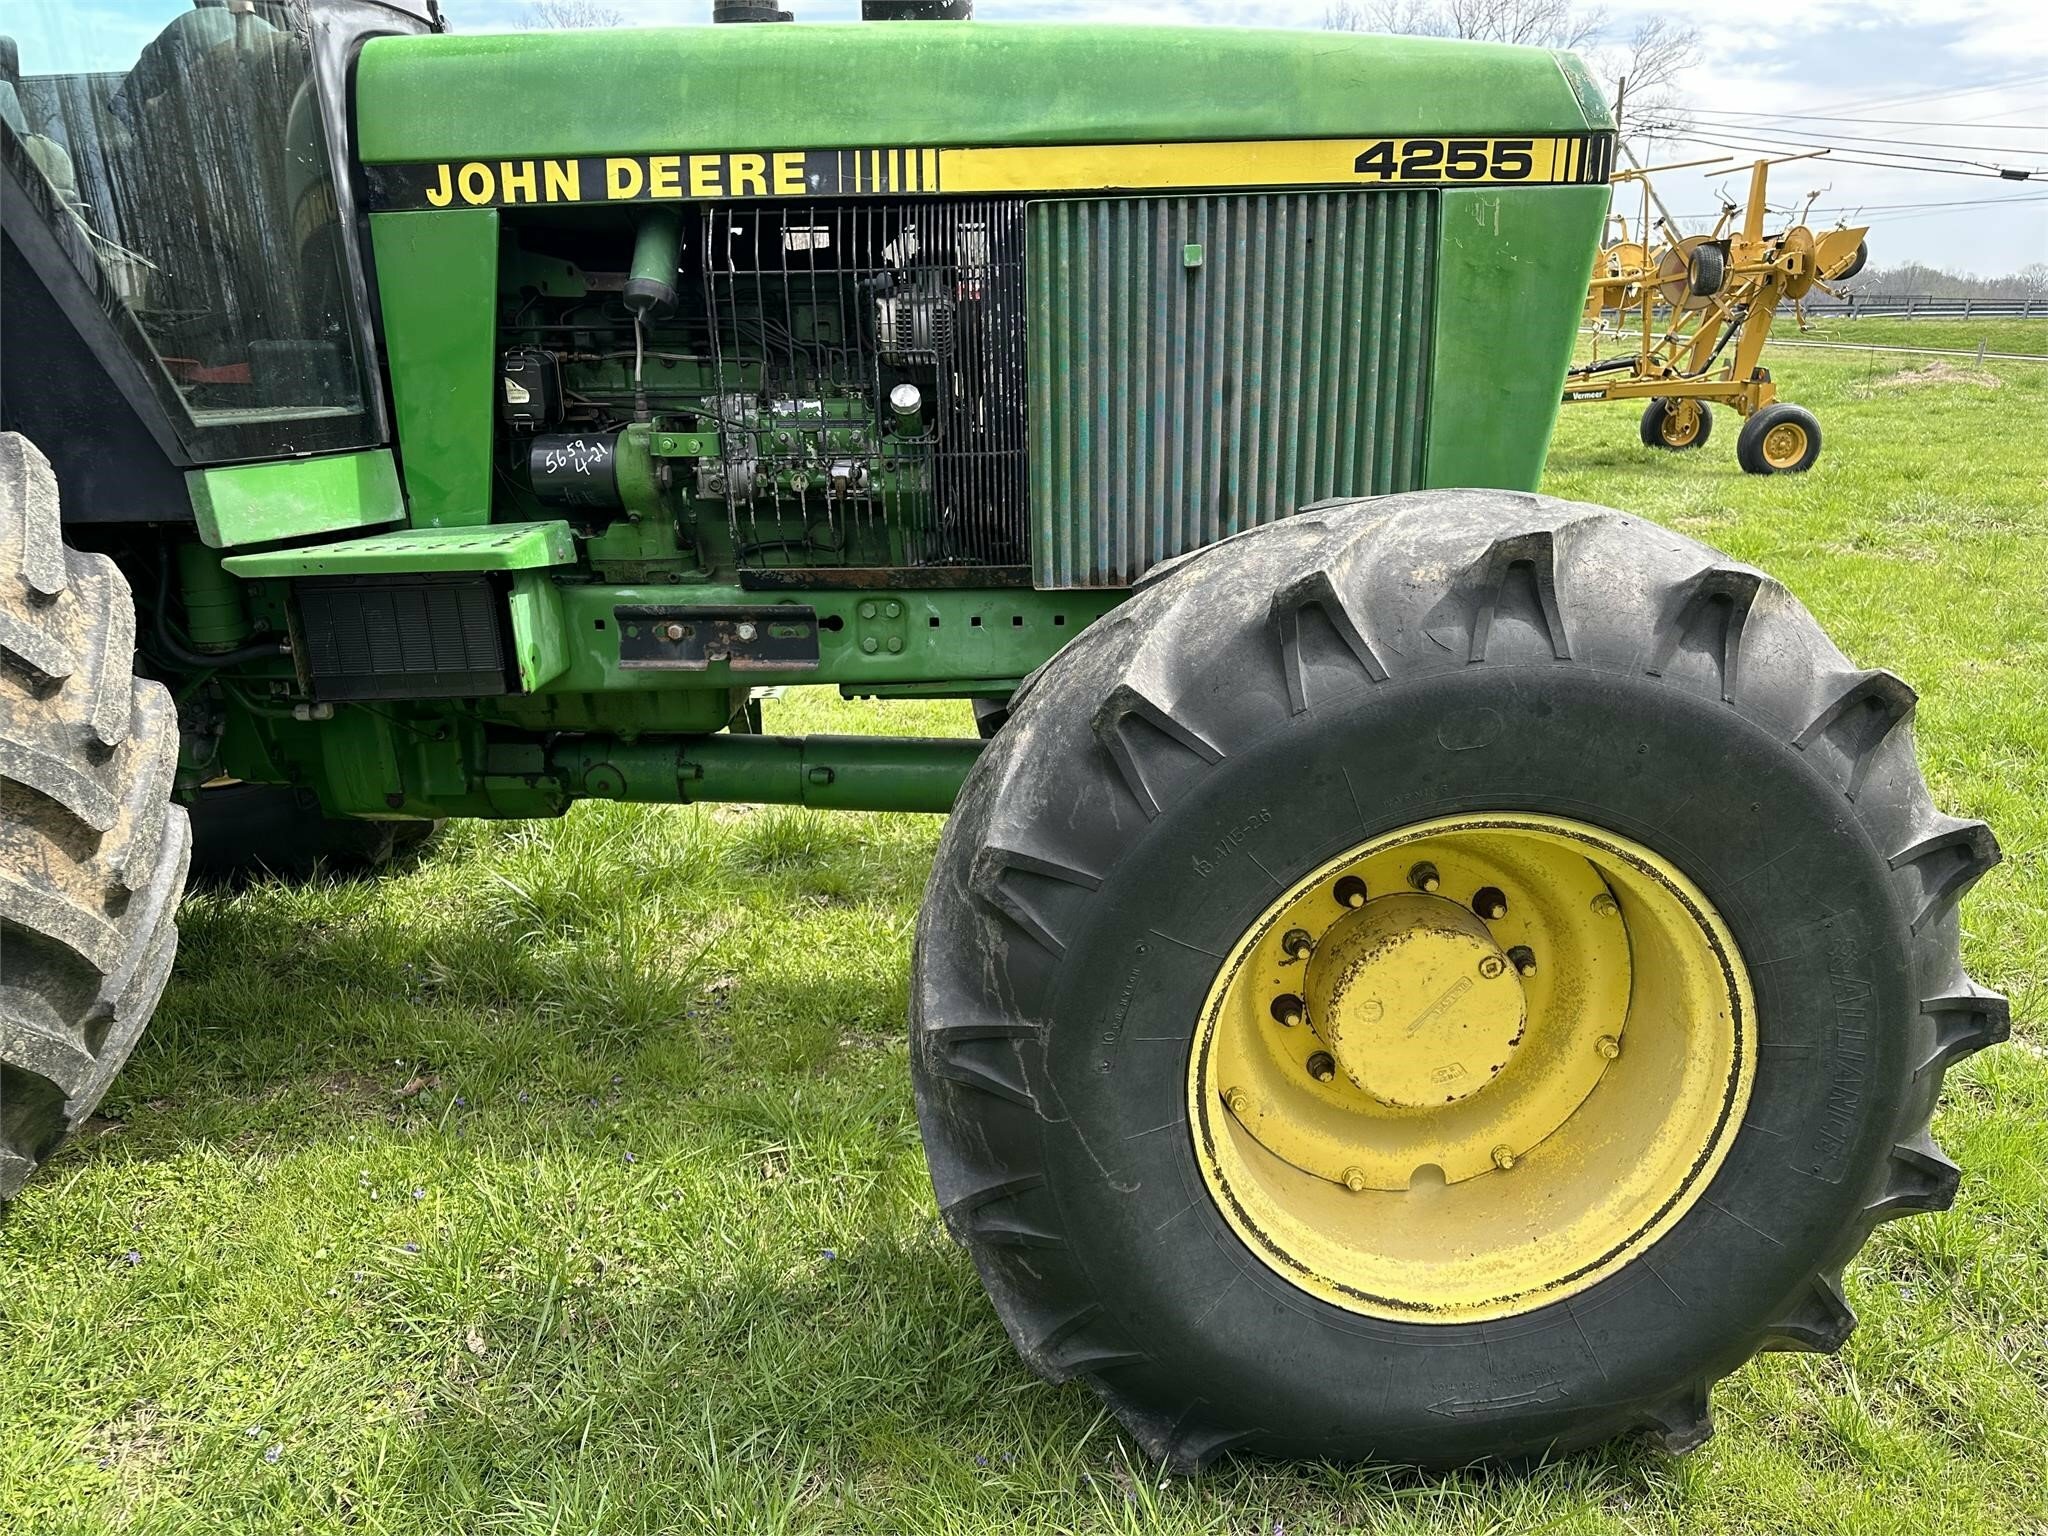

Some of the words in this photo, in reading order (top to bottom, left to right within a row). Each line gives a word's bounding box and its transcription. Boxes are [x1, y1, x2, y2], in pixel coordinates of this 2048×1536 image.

[1353, 140, 1534, 181] 4255
[425, 158, 582, 208] JOHN
[606, 151, 808, 200] DEERE
[1572, 390, 1604, 400] Vermeer
[574, 442, 609, 476] 4-21
